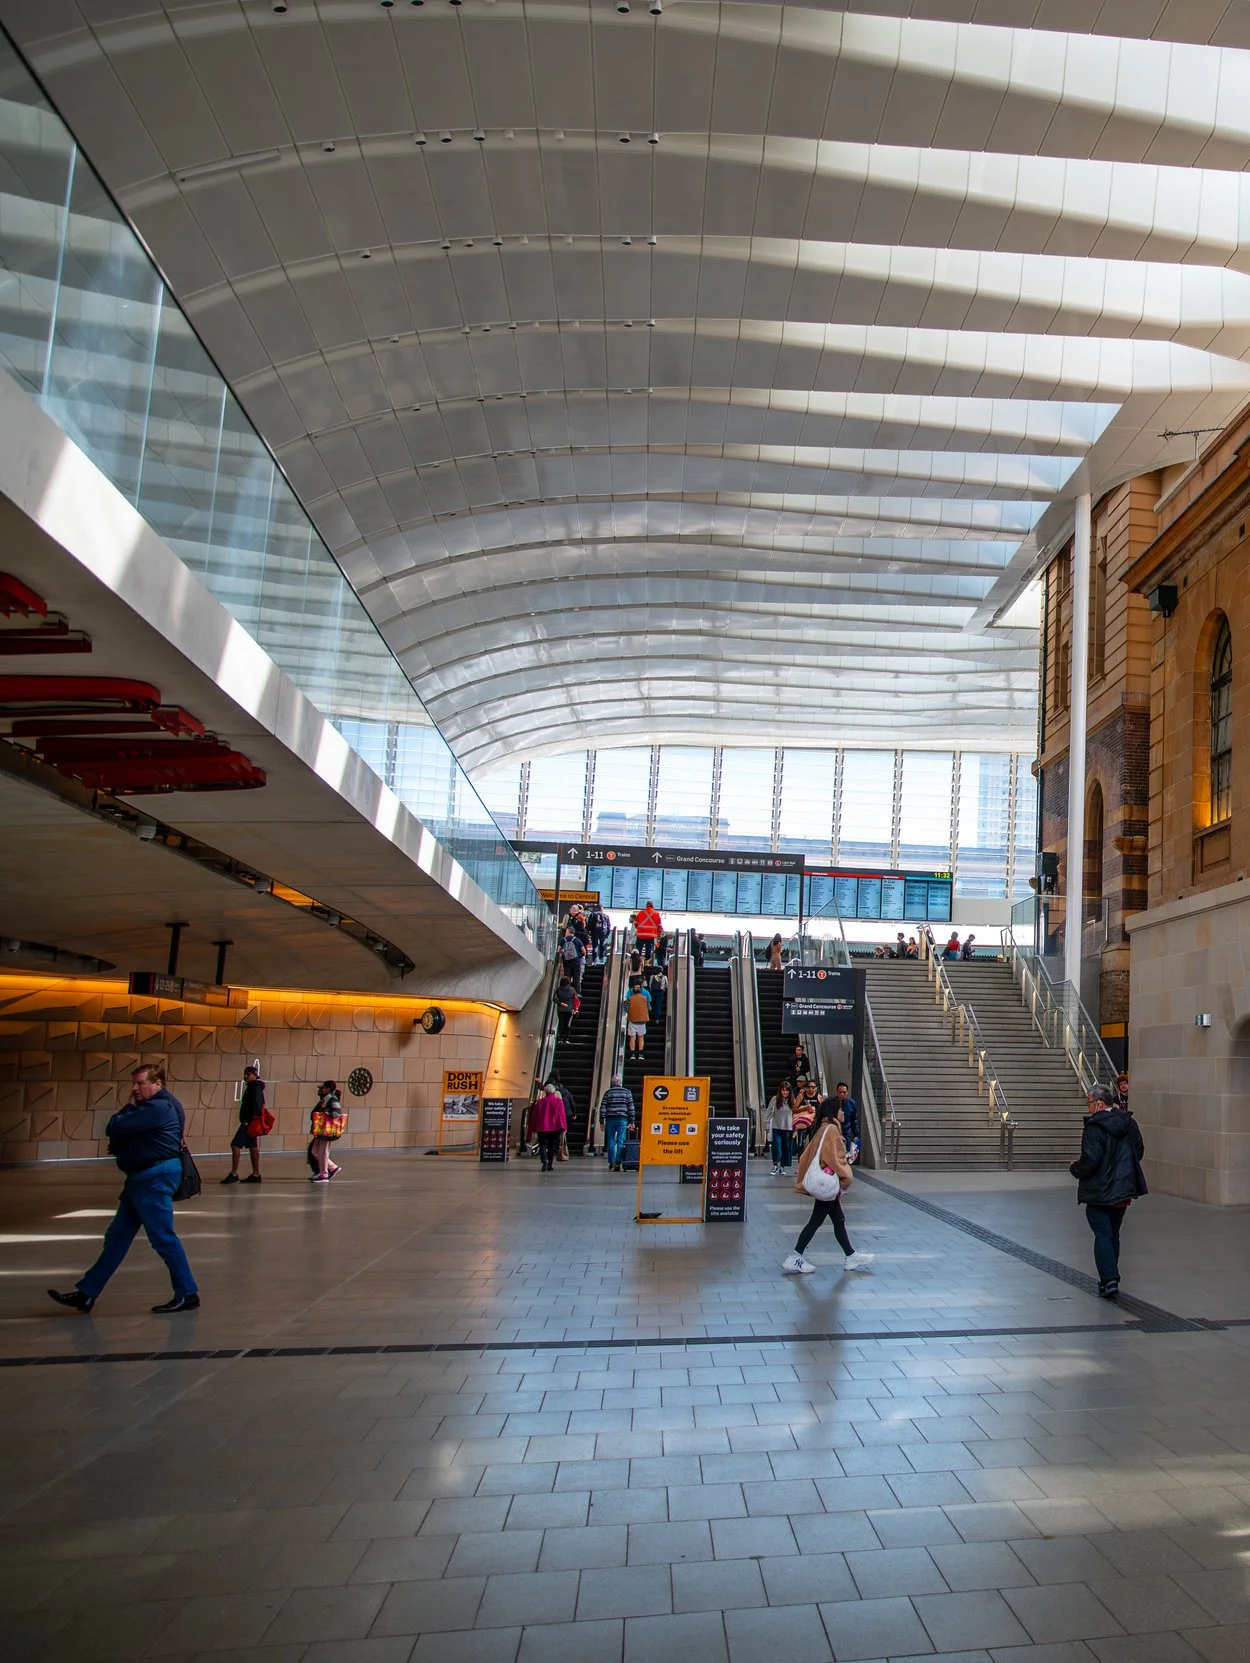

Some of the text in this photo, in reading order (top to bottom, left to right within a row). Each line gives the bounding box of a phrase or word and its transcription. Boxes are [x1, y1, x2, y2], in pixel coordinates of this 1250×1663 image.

[586, 851, 604, 859] 1-11
[694, 856, 725, 864] Concourse
[541, 891, 568, 899] Welcme
[798, 970, 816, 979] 1-11
[448, 1073, 479, 1081] DON'T
[447, 1081, 479, 1090] RUSH
